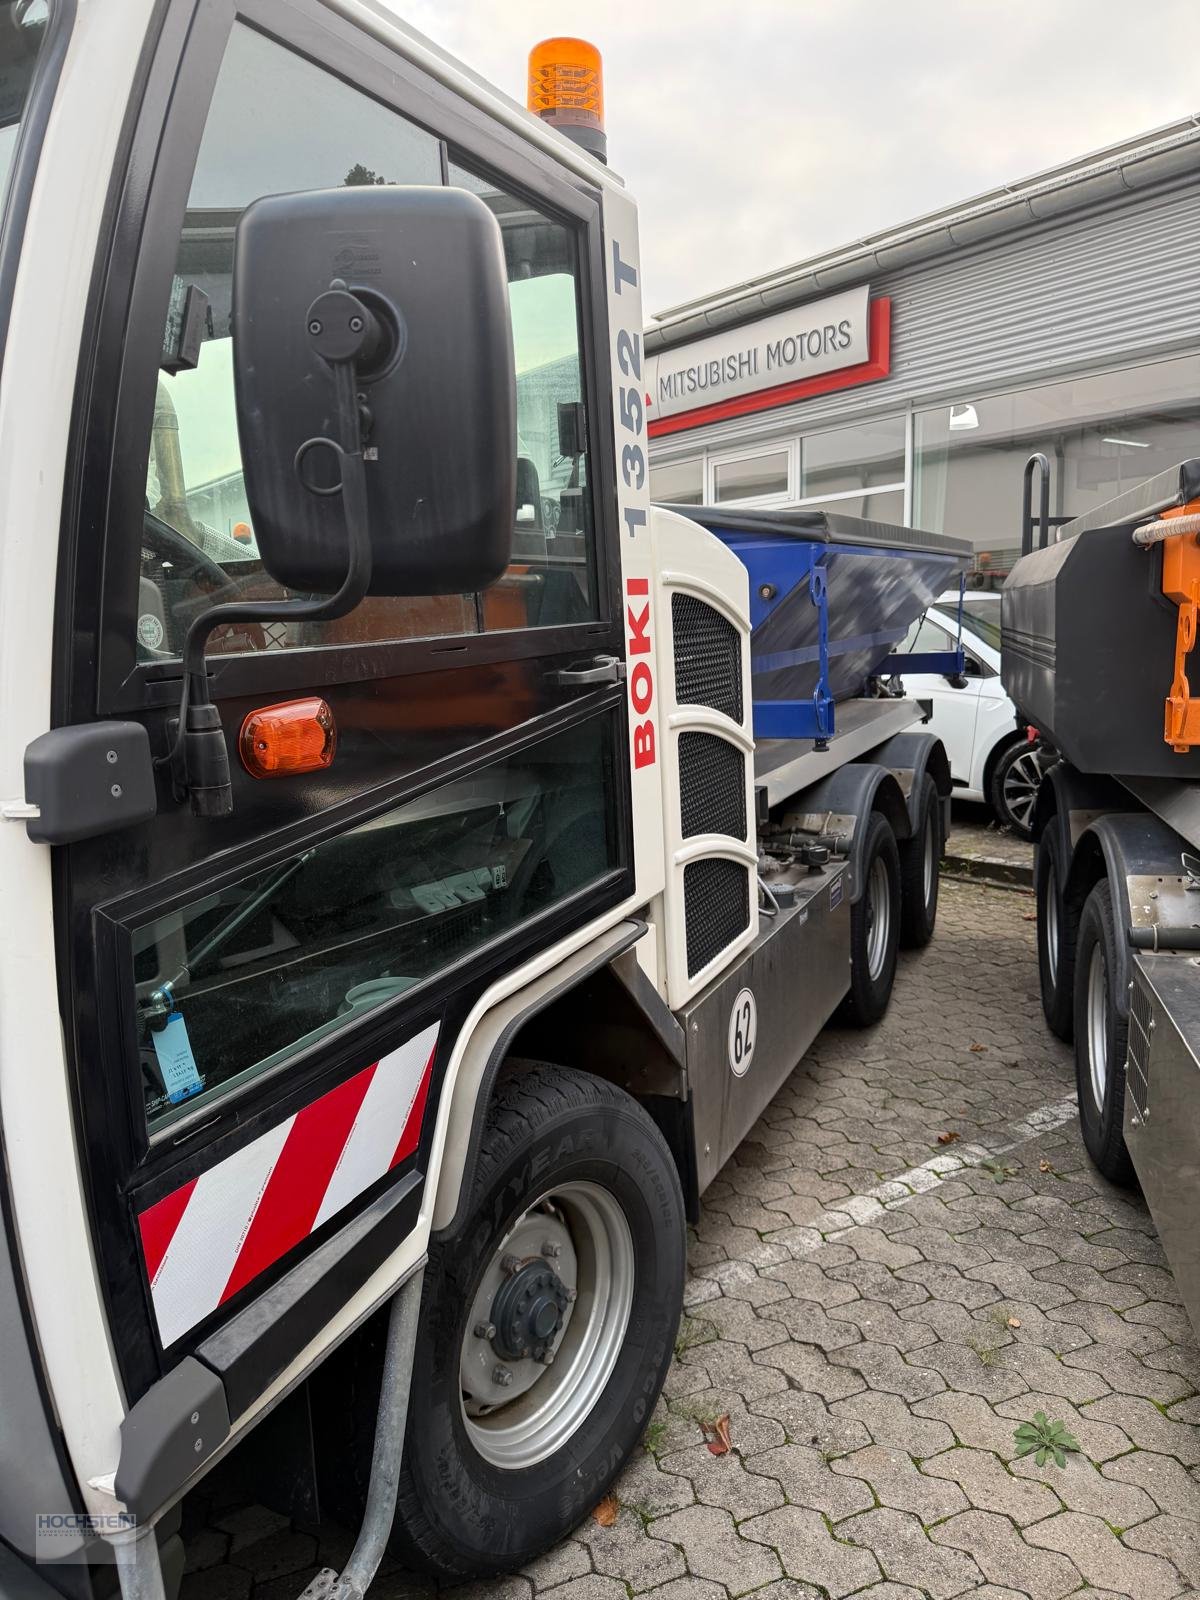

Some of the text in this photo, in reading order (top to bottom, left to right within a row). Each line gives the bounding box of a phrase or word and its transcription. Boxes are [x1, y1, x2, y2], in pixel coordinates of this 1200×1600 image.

[659, 319, 852, 401] MITSUBISHI MOTORS
[612, 239, 655, 769] BOKI 1352 T
[734, 1000, 752, 1065] 62
